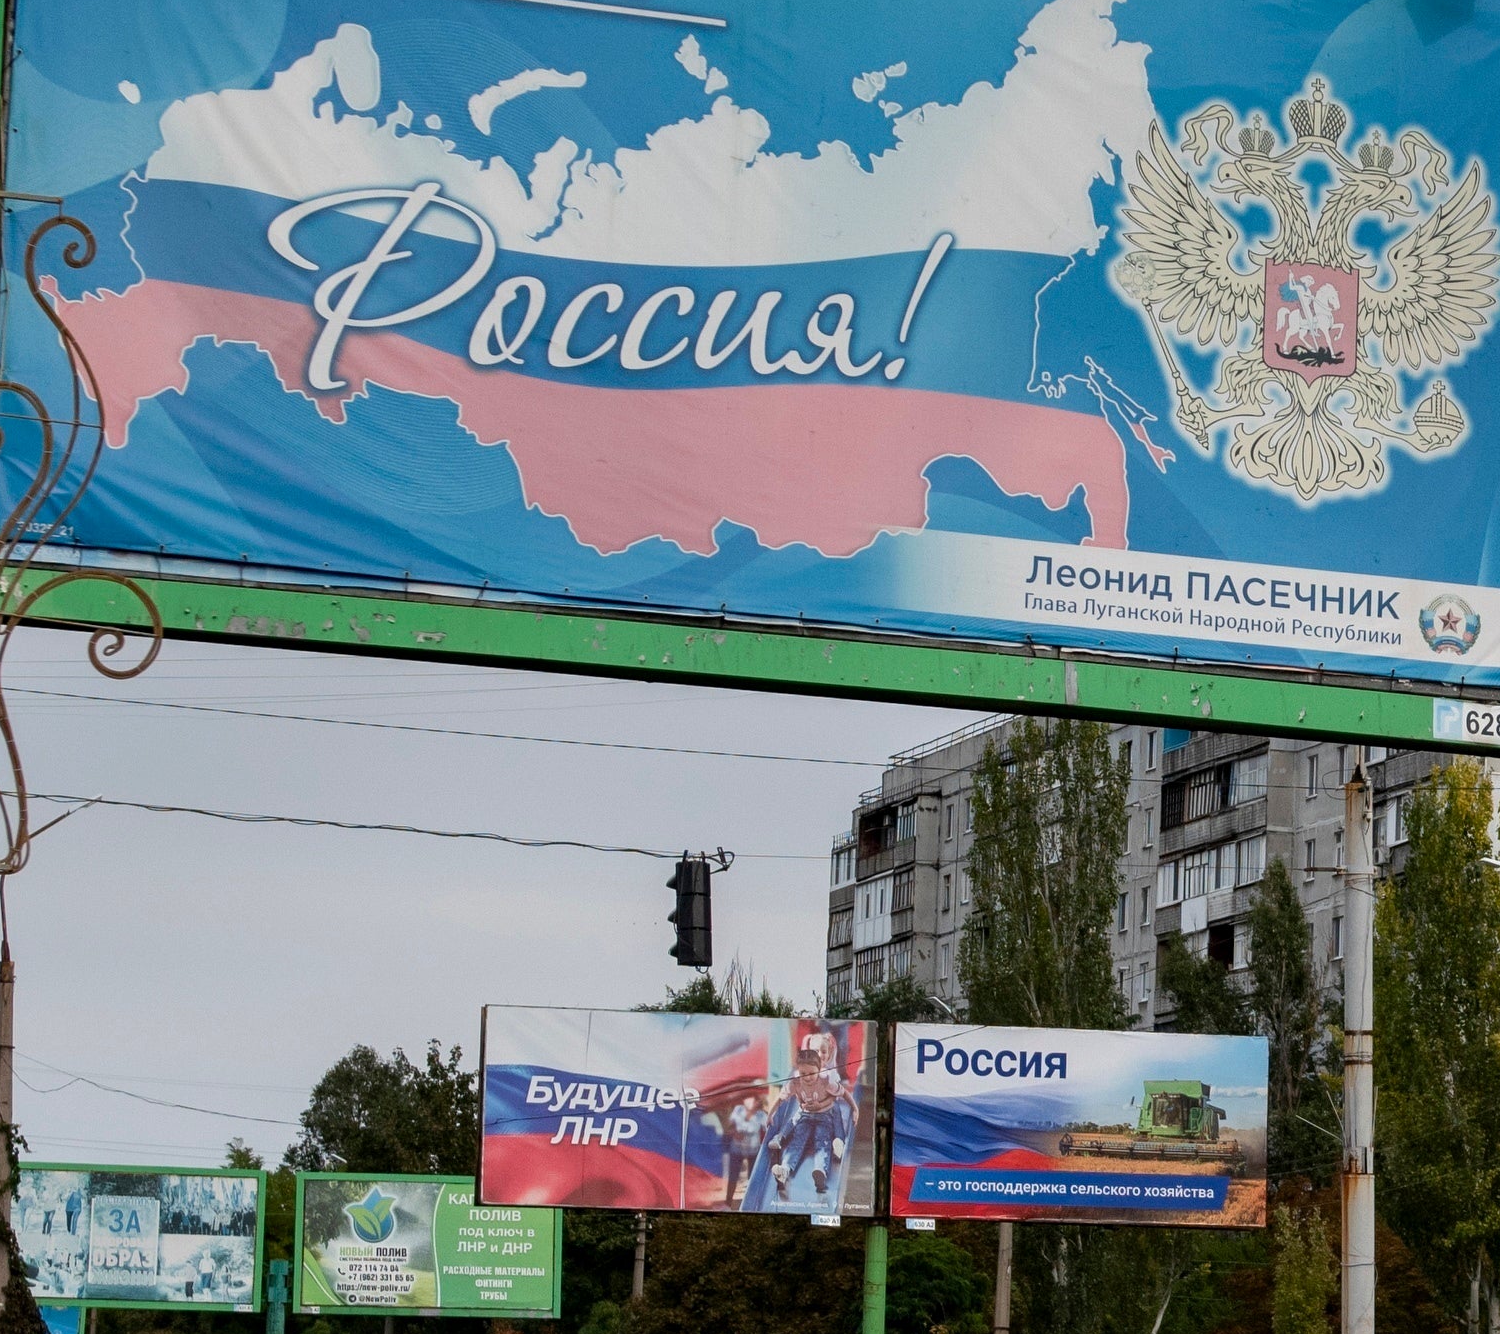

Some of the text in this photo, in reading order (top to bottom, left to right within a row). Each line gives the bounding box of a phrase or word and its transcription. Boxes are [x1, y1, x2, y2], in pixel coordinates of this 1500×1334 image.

[267, 182, 954, 390] Россия!
[1025, 555, 1401, 620] Леонид ПАСЕЧНИК
[1024, 592, 1402, 647] Глава Луганской Народной Республики
[916, 1037, 1068, 1079] Россия
[526, 1075, 699, 1113] Будущее
[550, 1115, 639, 1147] ЛНР
[937, 1179, 962, 1192] это
[965, 1181, 1067, 1196] господдержка
[1070, 1182, 1141, 1197] сельского
[1144, 1184, 1215, 1199] хозяйства
[448, 1193, 475, 1205] КАП
[108, 1208, 141, 1234] ЗА
[469, 1209, 521, 1221] ПОЛИВ
[459, 1227, 535, 1238] под ключ в
[339, 1245, 407, 1257] НОВЫЙ ПОЛИВ
[457, 1241, 533, 1255] ЛНР и ДНР
[93, 1249, 154, 1268] ОБРАЗ
[348, 1264, 363, 1272] 072
[443, 1266, 545, 1276] РАСХОДНЫЕ МАТЕРИАЛЫ
[475, 1279, 513, 1288] ФИТИНГИ
[480, 1291, 507, 1300] ТРУБЫ
